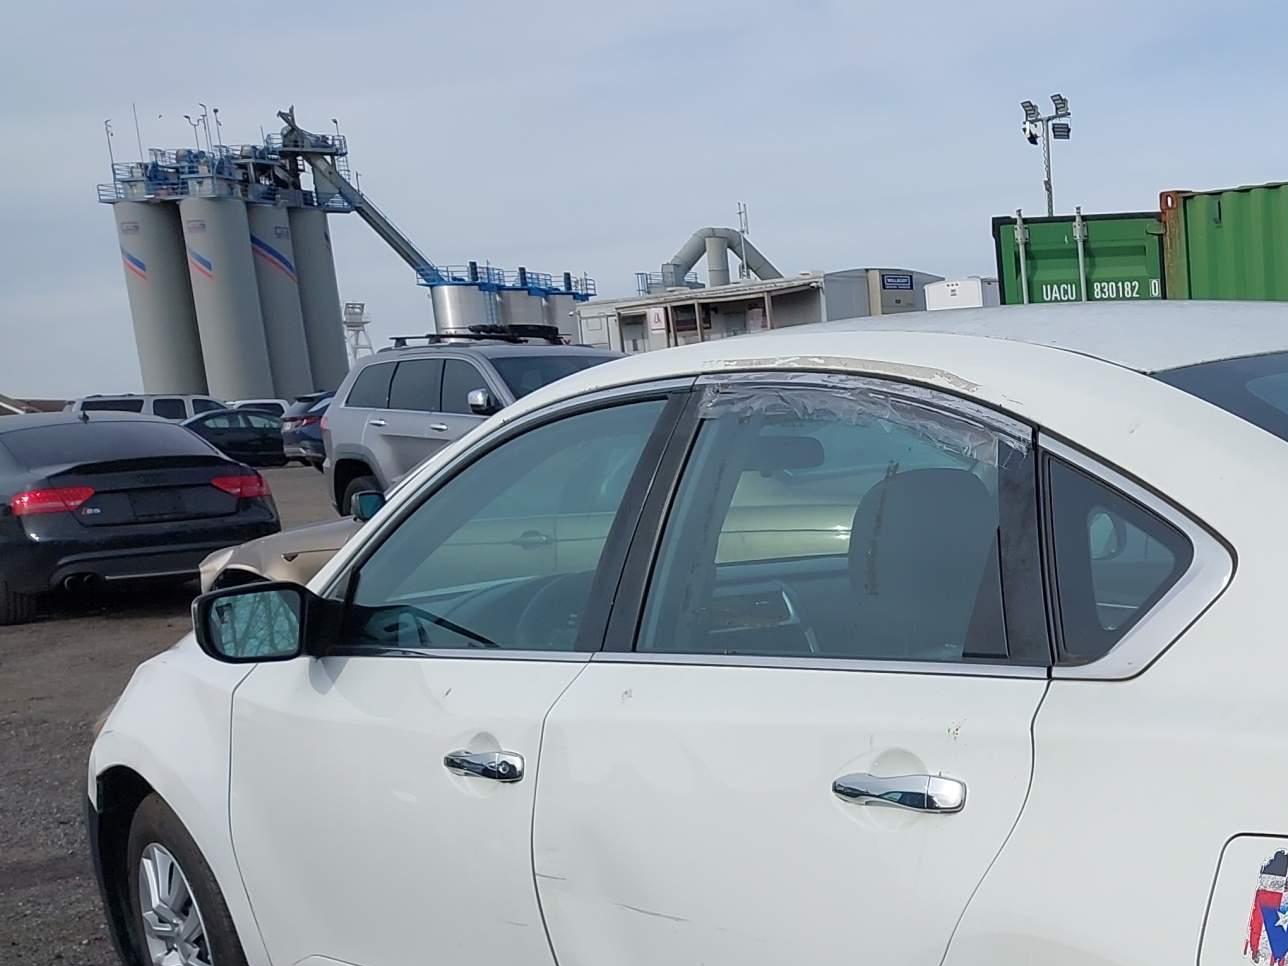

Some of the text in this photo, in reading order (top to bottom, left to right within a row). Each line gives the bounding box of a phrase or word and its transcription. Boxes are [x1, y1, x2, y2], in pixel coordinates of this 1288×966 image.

[1042, 279, 1159, 301] UACU 830182 0
